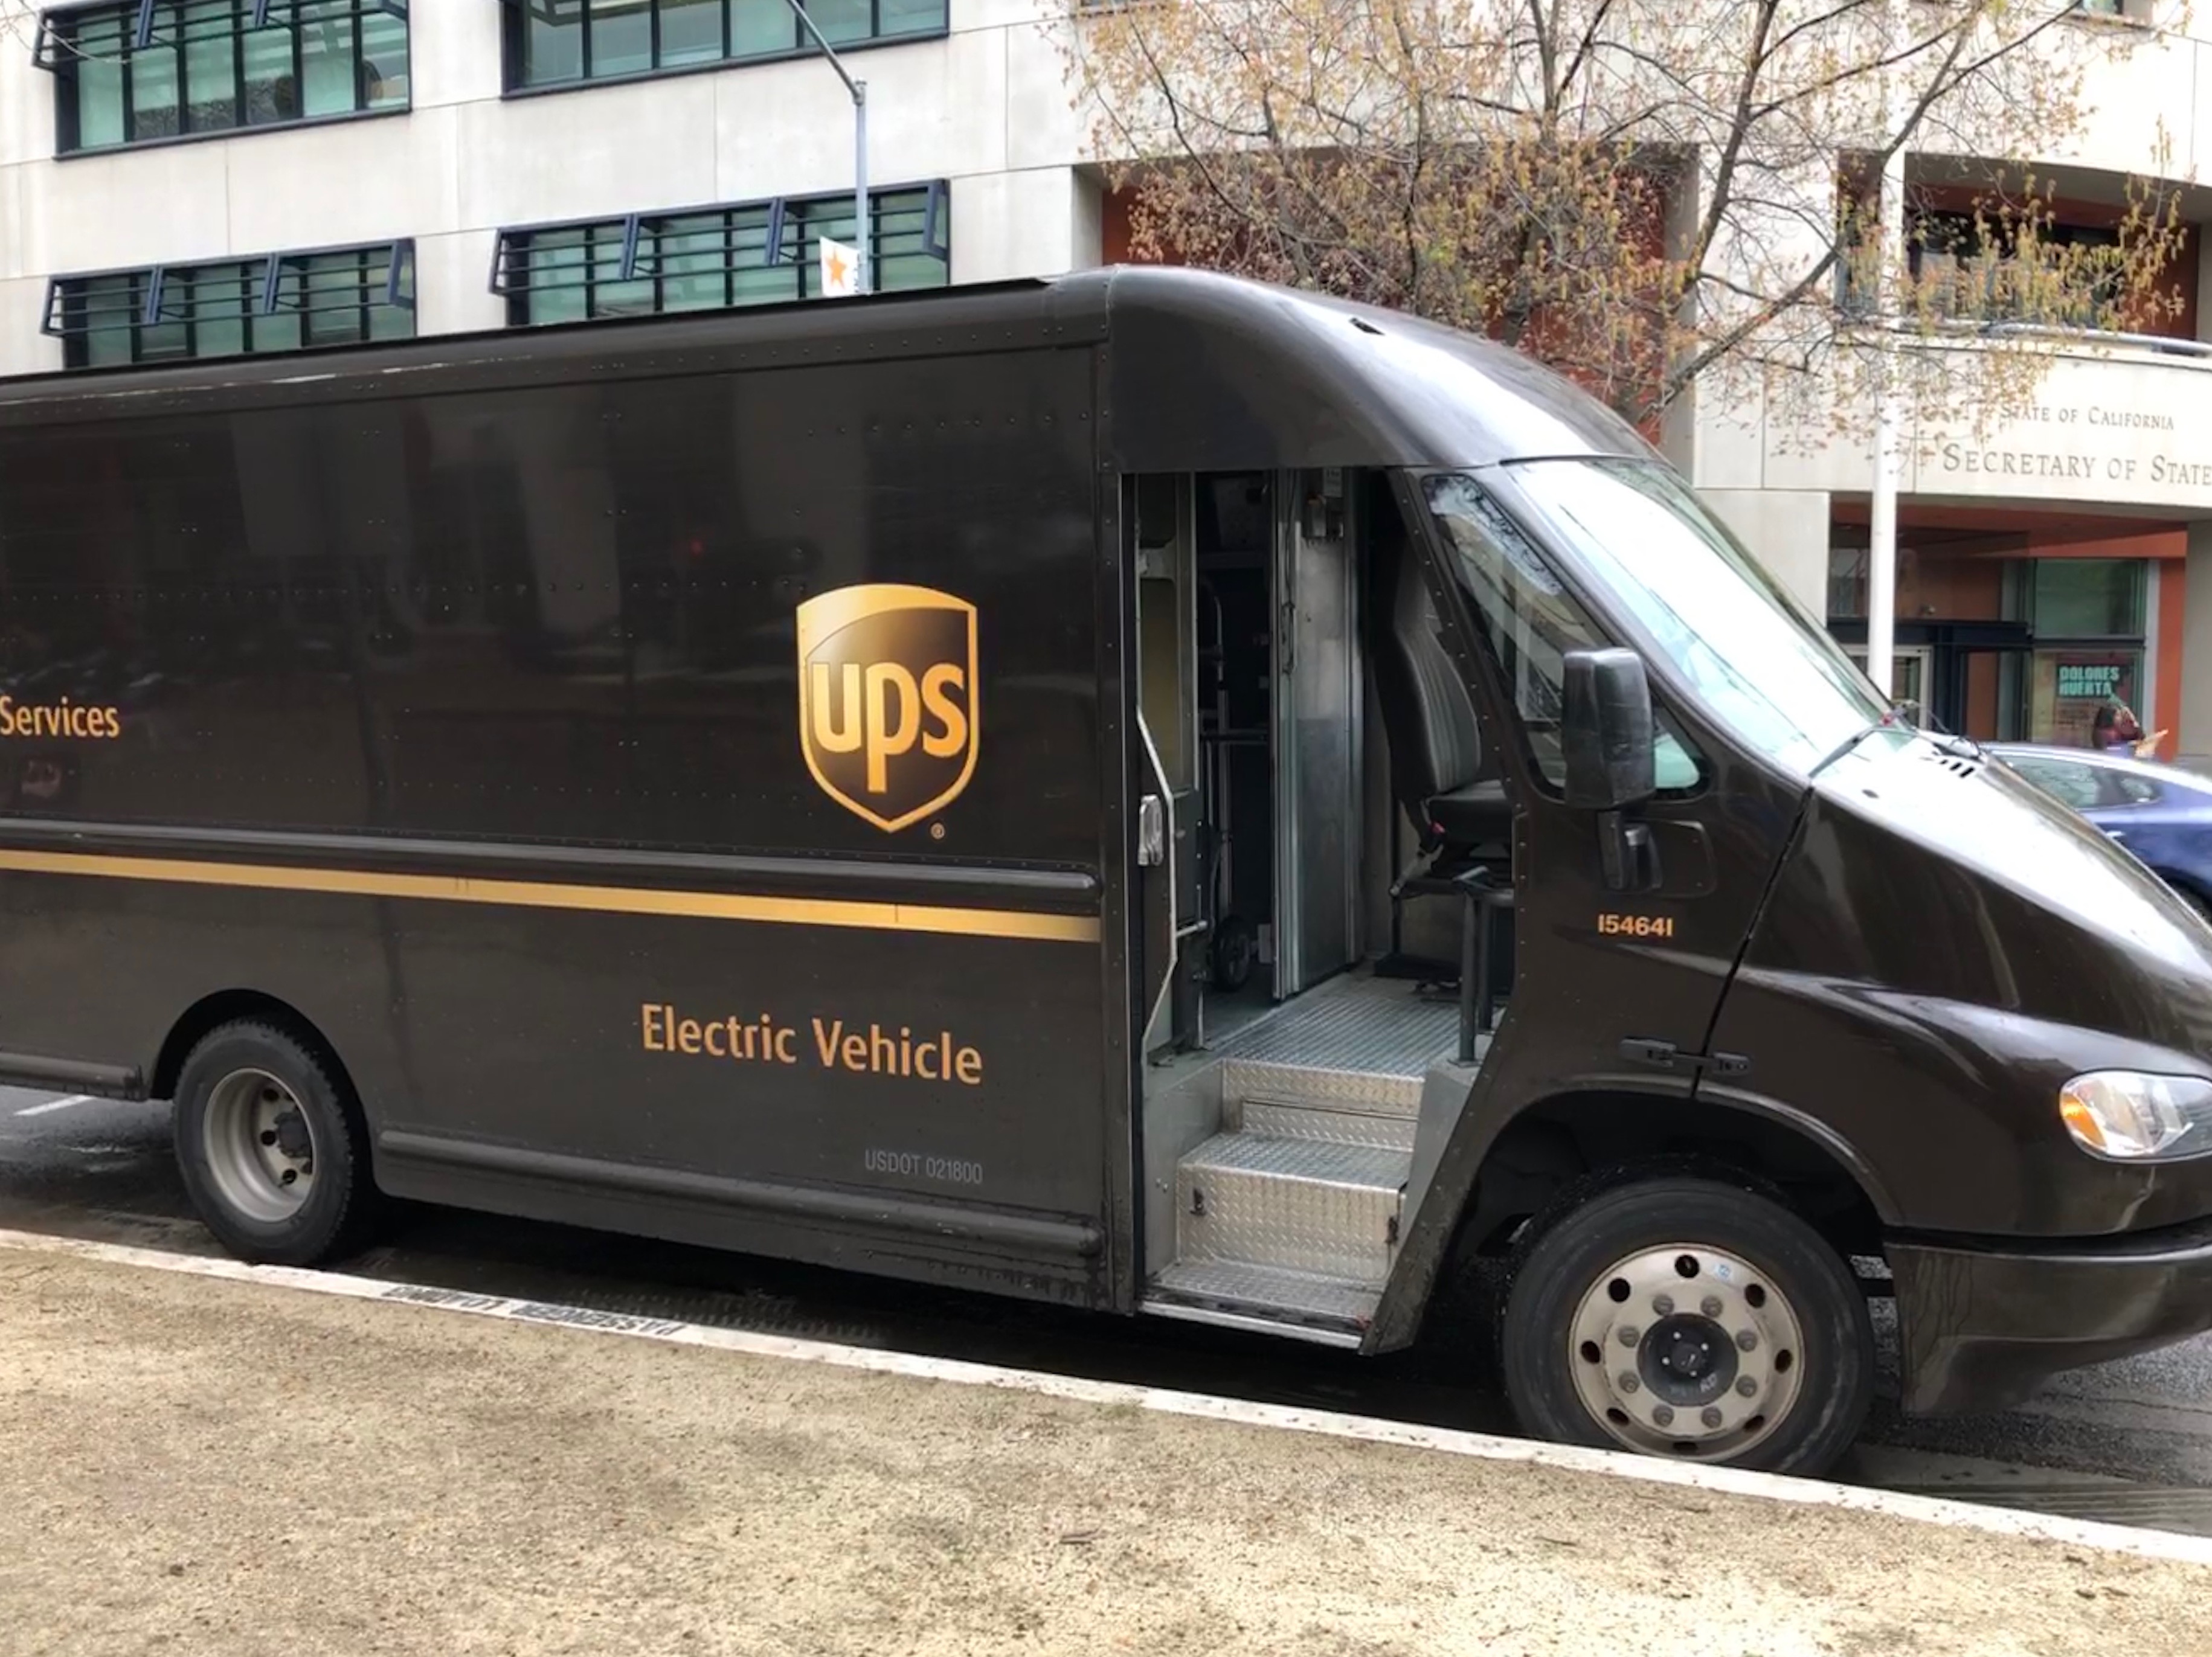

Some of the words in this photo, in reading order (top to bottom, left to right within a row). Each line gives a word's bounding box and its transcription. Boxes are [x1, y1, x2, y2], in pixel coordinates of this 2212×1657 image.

[2059, 408, 2078, 423] OF
[2089, 406, 2174, 430] CALIFORNIA
[1943, 443, 2096, 478] SECRETARY
[2108, 457, 2136, 481] OF
[2150, 454, 2212, 486] STATE
[2059, 665, 2120, 681] DOLORES
[0, 696, 120, 738] Services
[812, 662, 968, 793] ups
[1597, 913, 1673, 937] 154641
[642, 1003, 797, 1063] Electric
[812, 1018, 983, 1085] Vehicle
[864, 1148, 921, 1176] USDOT
[925, 1156, 983, 1184] 021800
